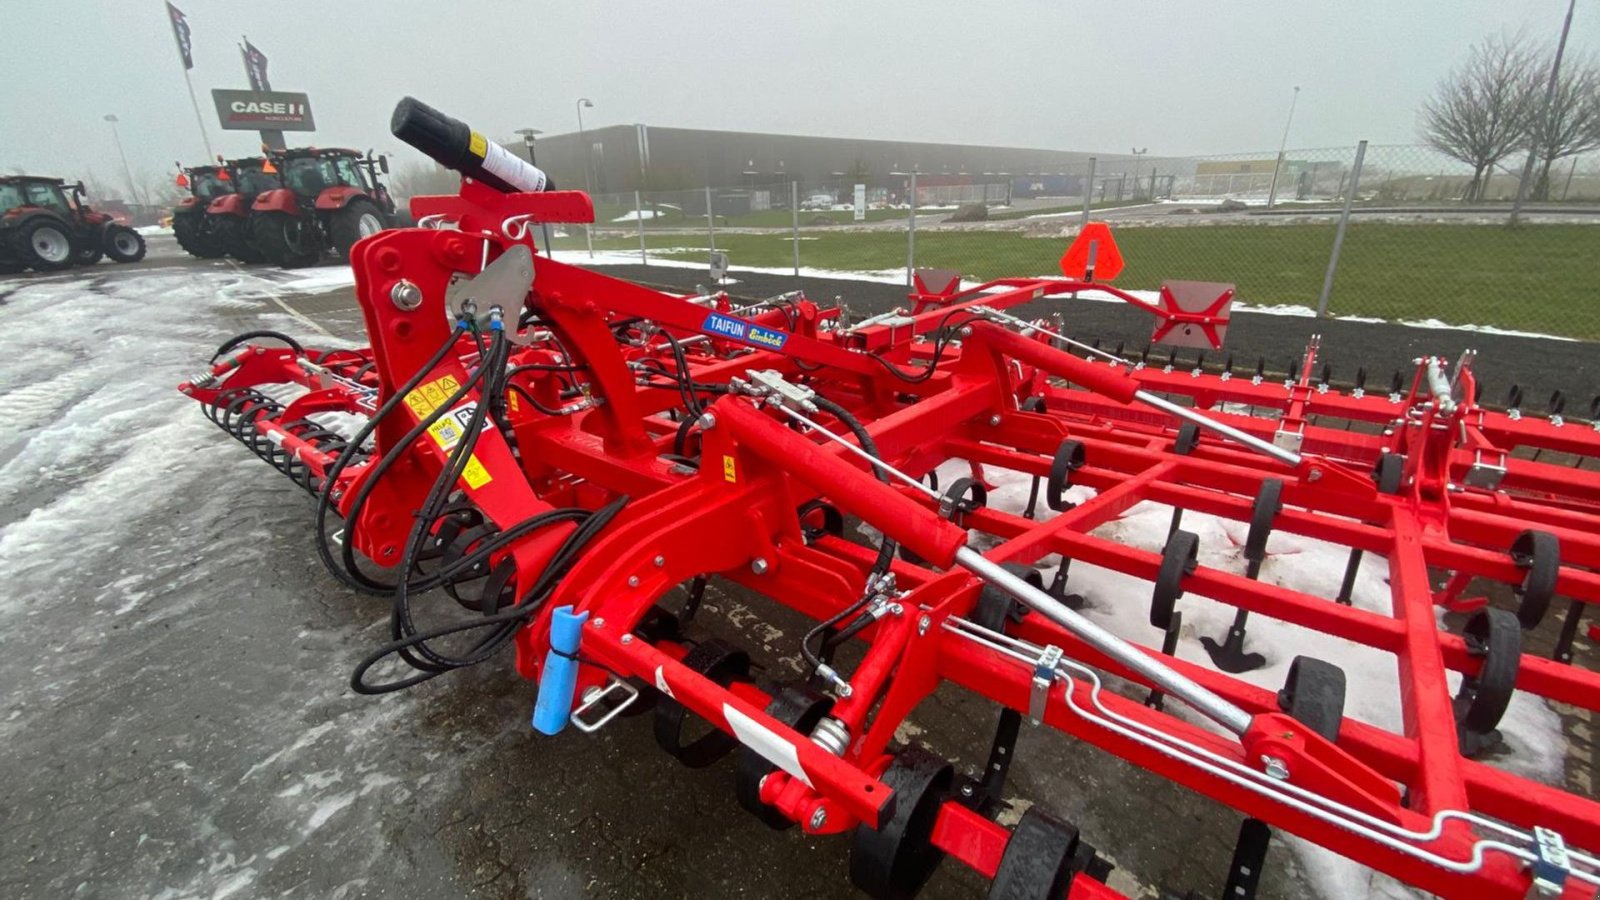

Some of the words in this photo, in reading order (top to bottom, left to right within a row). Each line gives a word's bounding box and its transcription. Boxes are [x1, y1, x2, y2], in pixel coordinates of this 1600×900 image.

[231, 101, 286, 114] CASE
[711, 316, 745, 337] TAIFUN
[749, 329, 783, 347] Einböck
